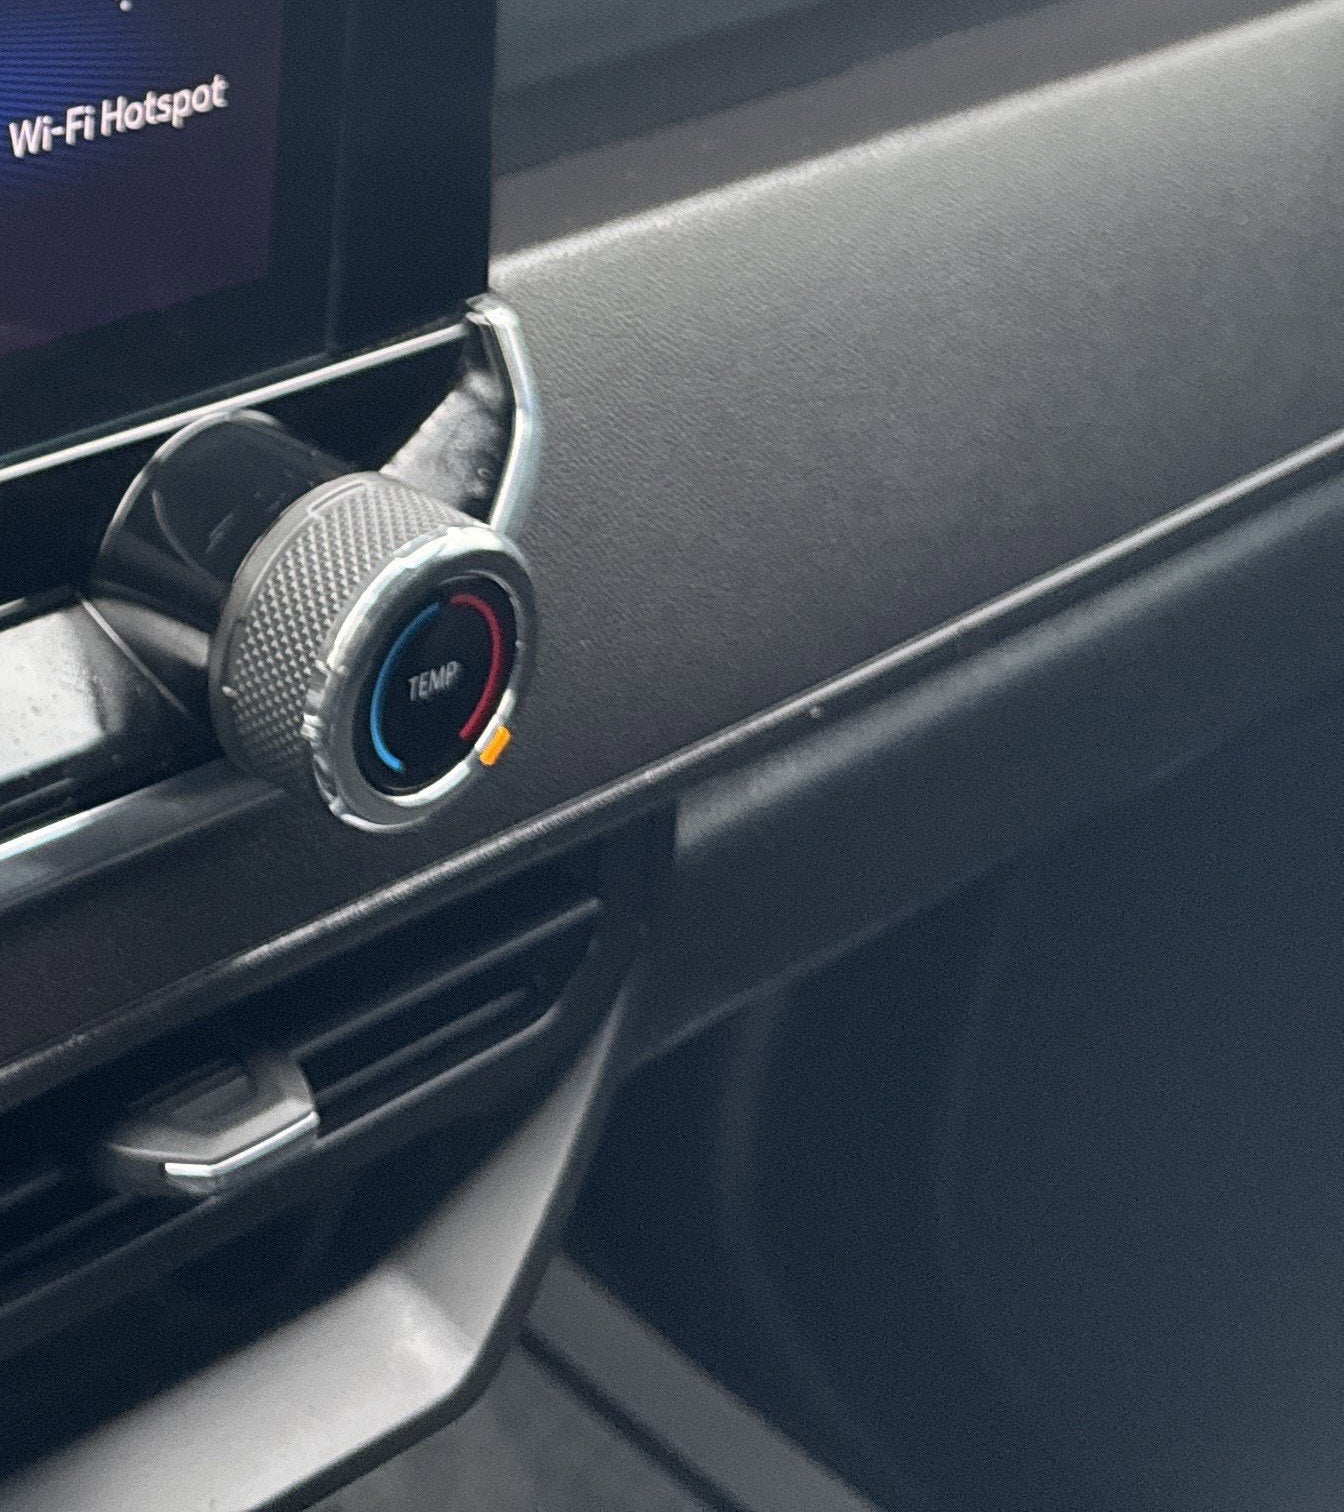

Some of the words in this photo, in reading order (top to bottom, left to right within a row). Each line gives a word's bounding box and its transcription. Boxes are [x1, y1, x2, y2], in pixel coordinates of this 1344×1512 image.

[8, 105, 96, 158] Wi-Fi
[100, 74, 228, 137] Hotspot
[407, 660, 460, 702] TEMP
